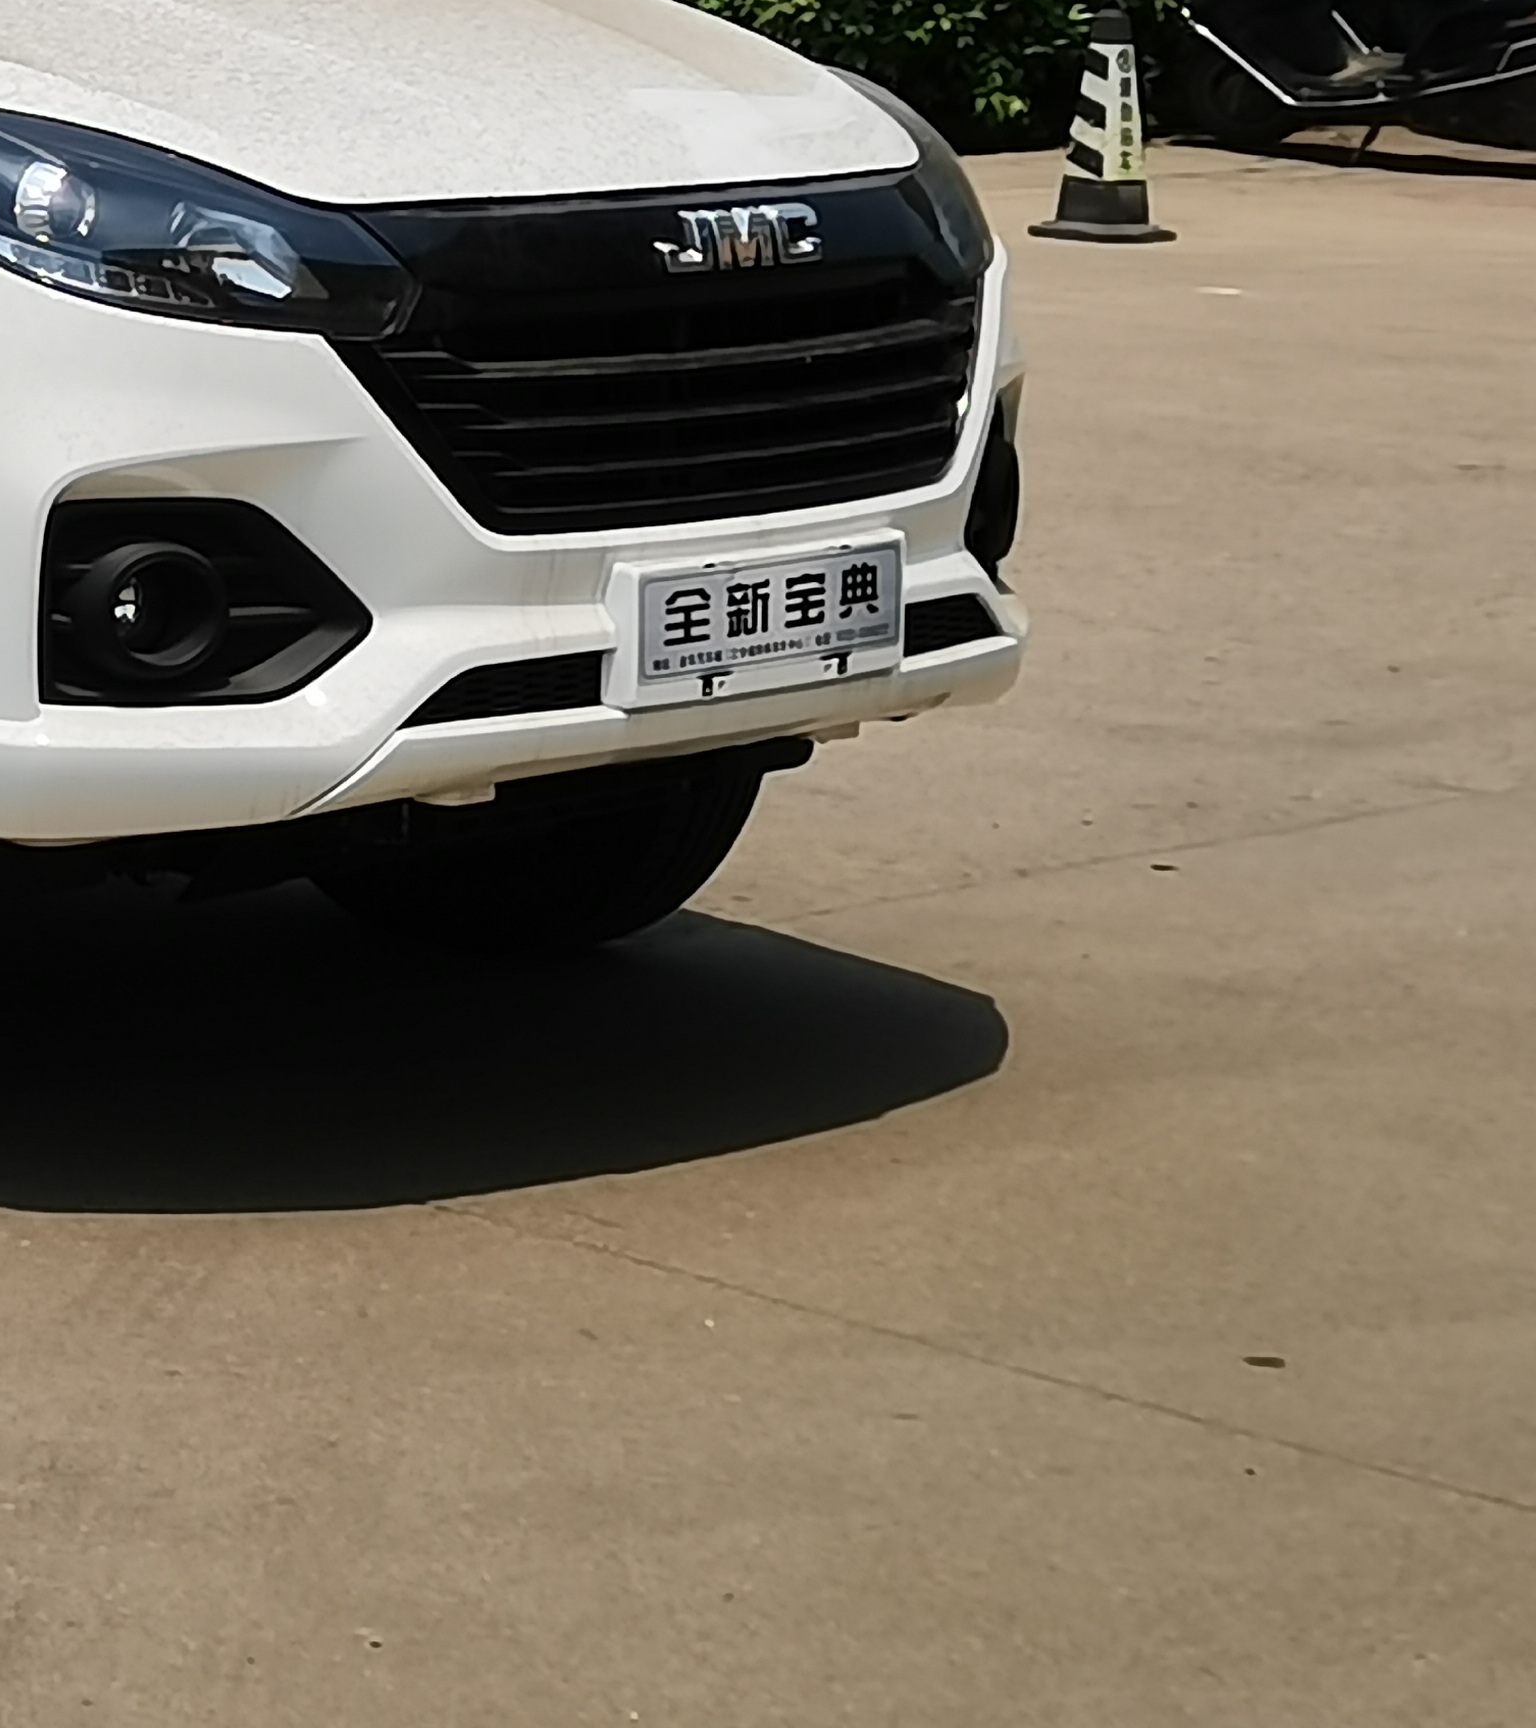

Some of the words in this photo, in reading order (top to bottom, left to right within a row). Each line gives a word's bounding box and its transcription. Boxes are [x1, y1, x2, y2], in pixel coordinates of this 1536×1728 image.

[653, 202, 823, 273] JMC
[663, 562, 879, 647] 全新宝典
